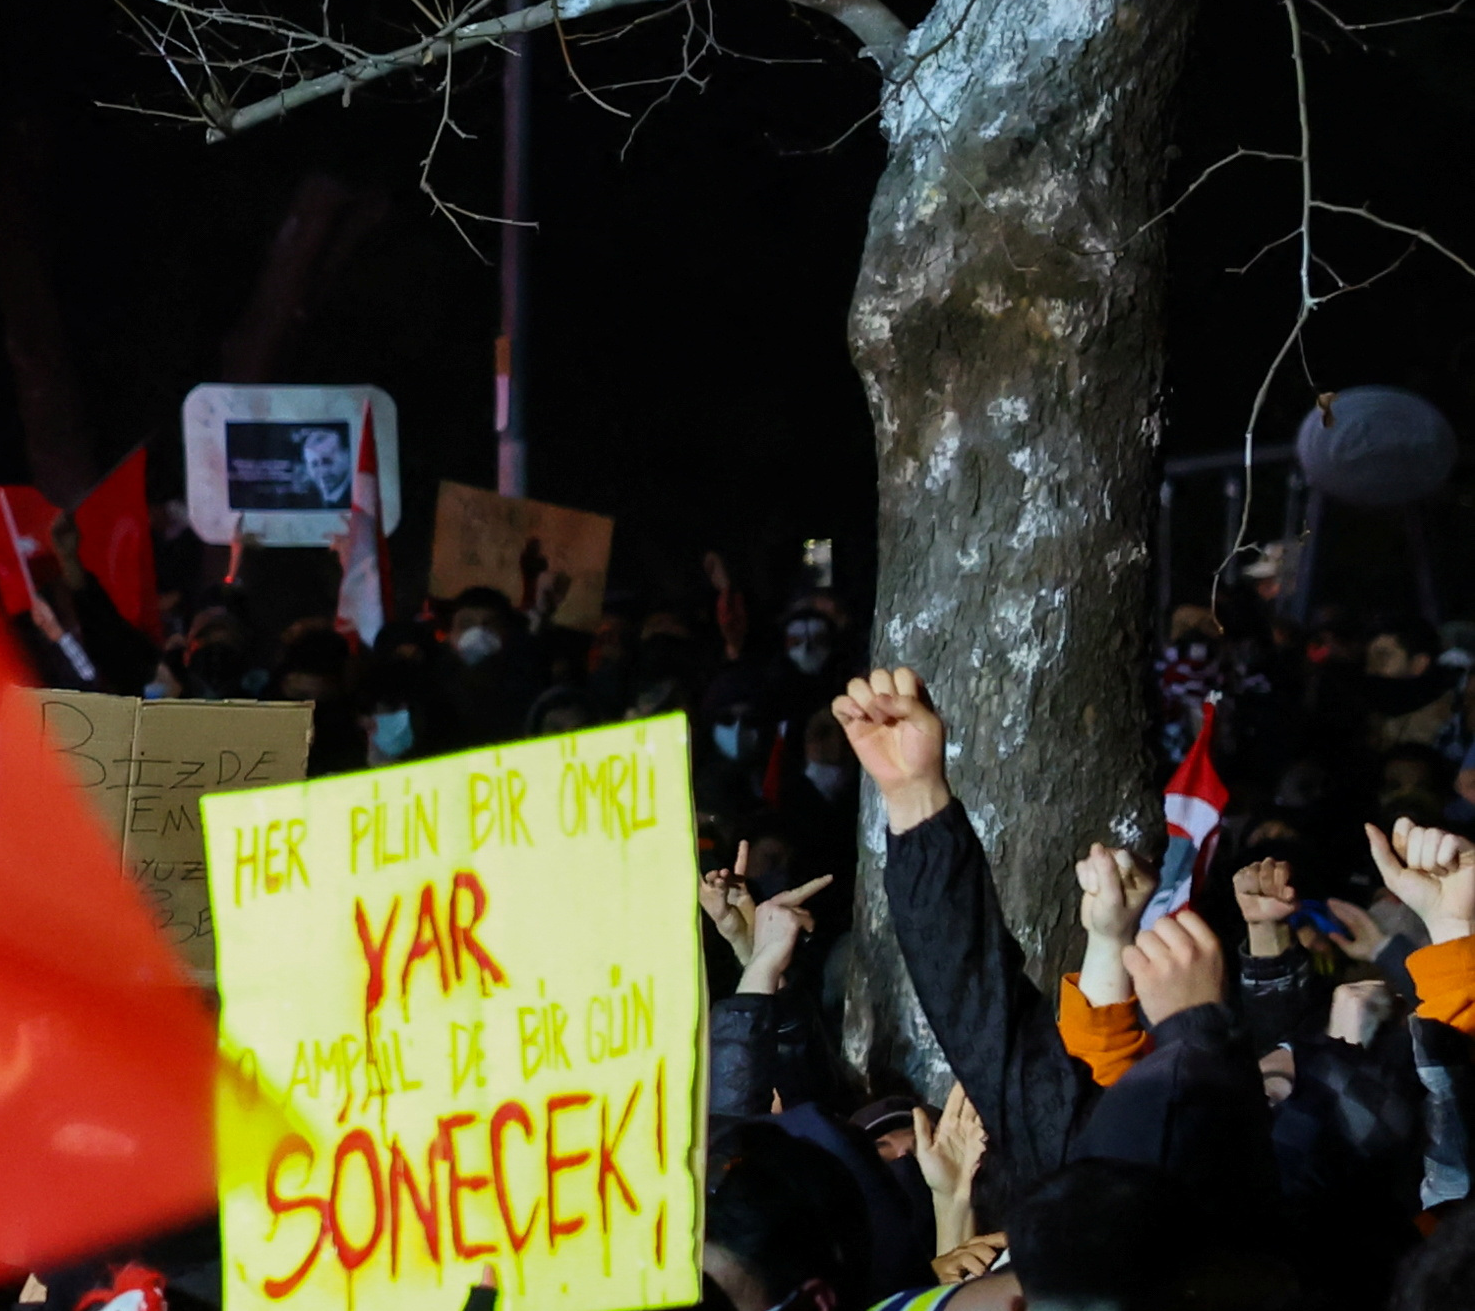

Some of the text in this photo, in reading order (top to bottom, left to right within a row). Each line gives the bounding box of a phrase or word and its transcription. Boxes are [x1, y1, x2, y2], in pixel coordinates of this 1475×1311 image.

[233, 817, 311, 908] HER
[468, 749, 534, 852] BİR
[558, 727, 658, 840] ÖMRÜ
[353, 867, 511, 1015] YAR
[448, 1020, 486, 1099] DE
[516, 977, 573, 1082] BİR
[585, 964, 655, 1064] GÜN
